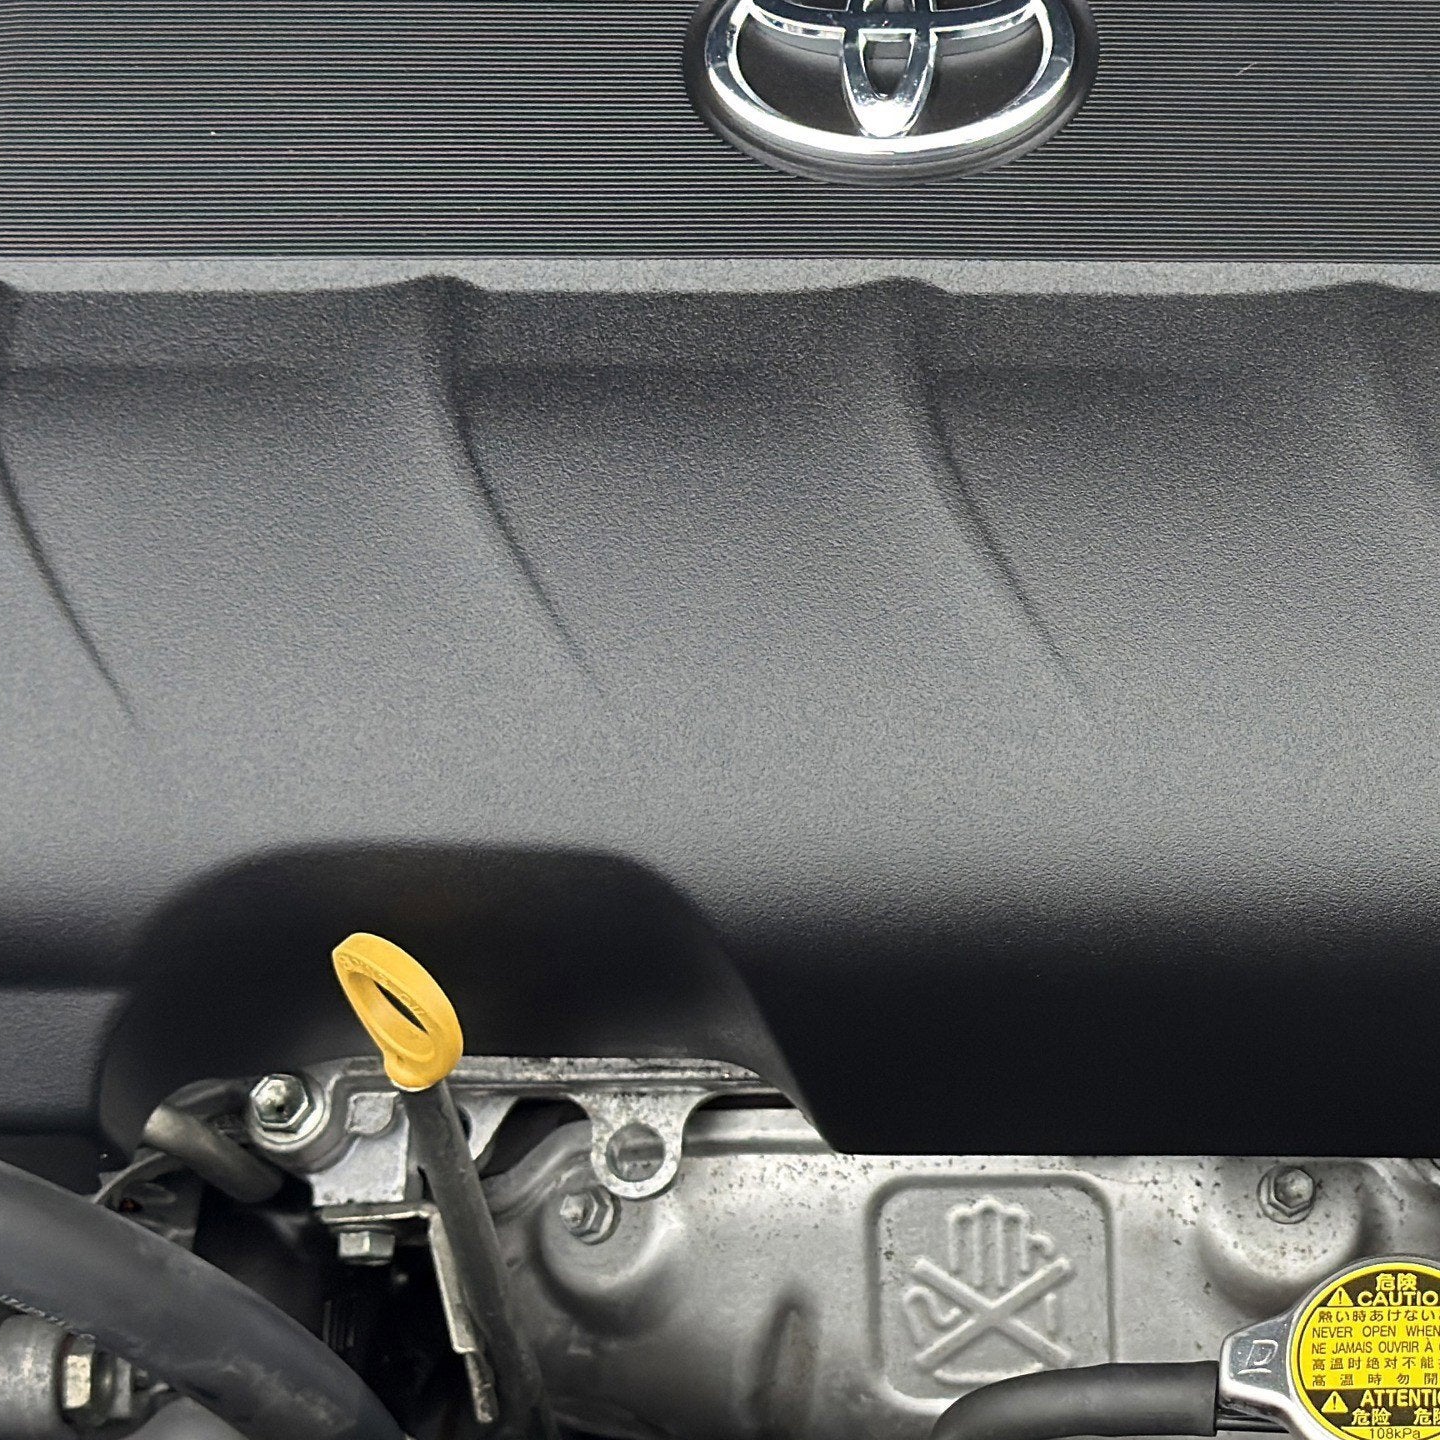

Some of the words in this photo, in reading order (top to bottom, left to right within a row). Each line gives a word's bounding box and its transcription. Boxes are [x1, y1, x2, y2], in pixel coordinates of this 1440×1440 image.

[1376, 1273, 1417, 1291] 危険
[1312, 1326, 1353, 1338] NEVER
[1363, 1326, 1396, 1337] OPEN
[1406, 1325, 1440, 1337] WHEN
[1311, 1342, 1327, 1355] NE
[1332, 1341, 1372, 1354] JAMAIS
[1378, 1341, 1419, 1353] OUVRIR
[1424, 1340, 1433, 1353] À
[1351, 1408, 1391, 1425] 危险
[1369, 1427, 1421, 1440] 108kPa
